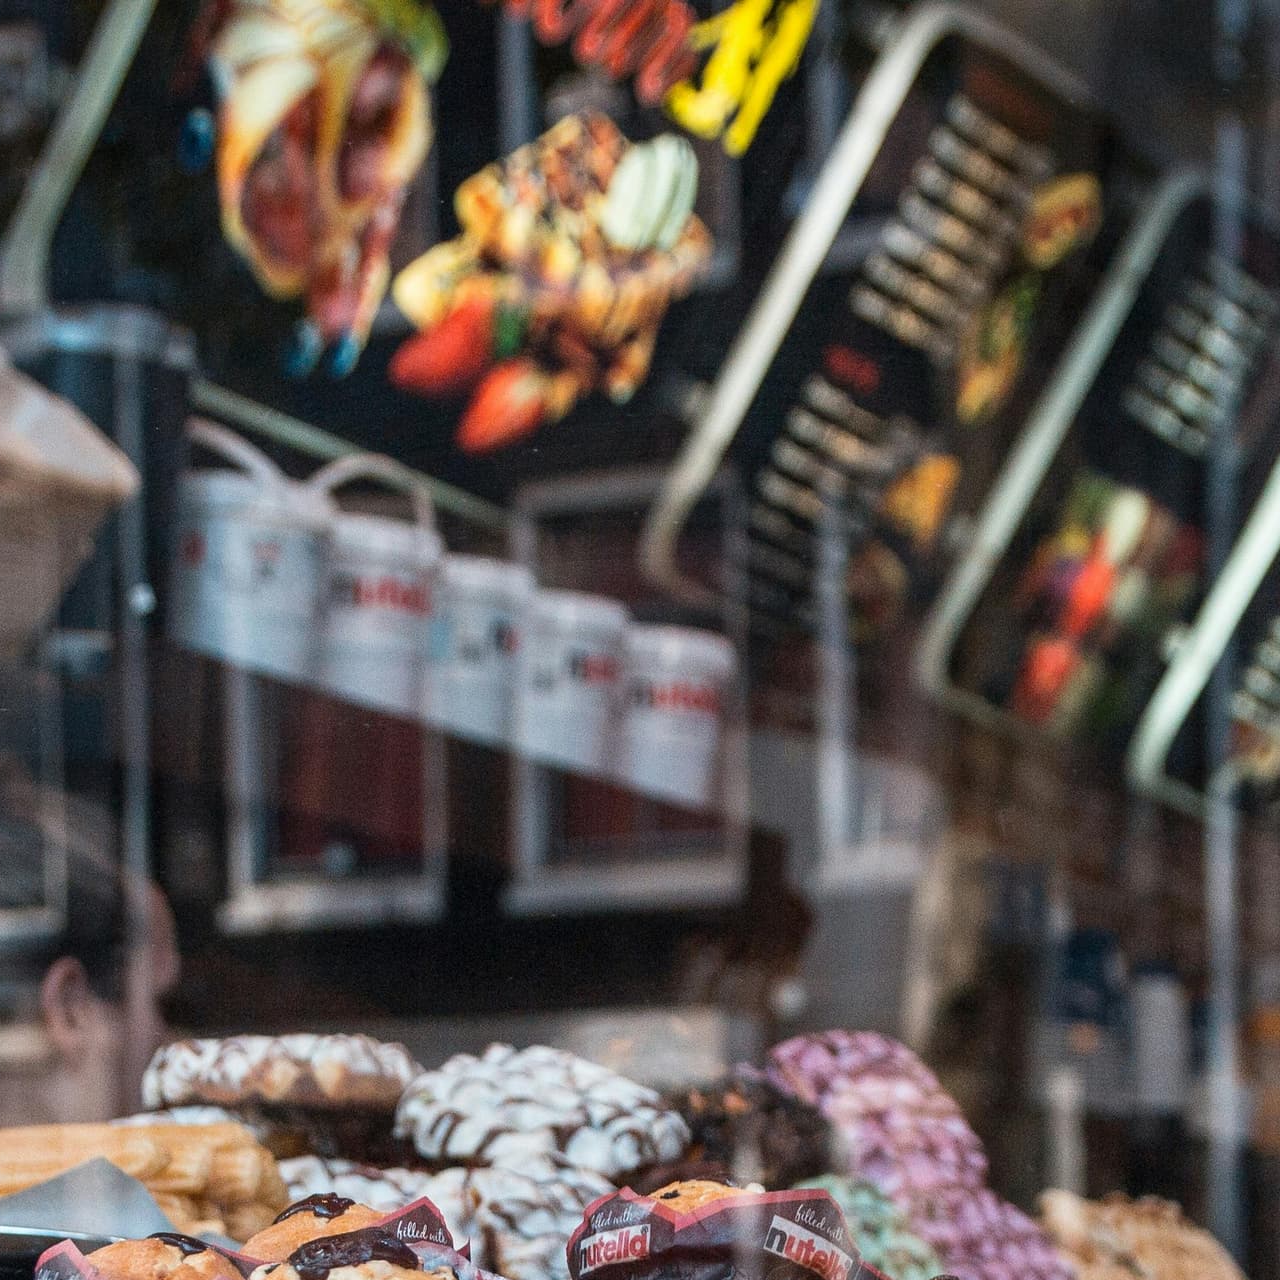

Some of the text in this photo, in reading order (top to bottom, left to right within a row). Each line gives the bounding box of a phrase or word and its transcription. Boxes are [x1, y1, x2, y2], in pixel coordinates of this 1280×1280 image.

[396, 1219, 428, 1240] filled
[794, 1203, 826, 1230] filled
[580, 1229, 649, 1271] nutella
